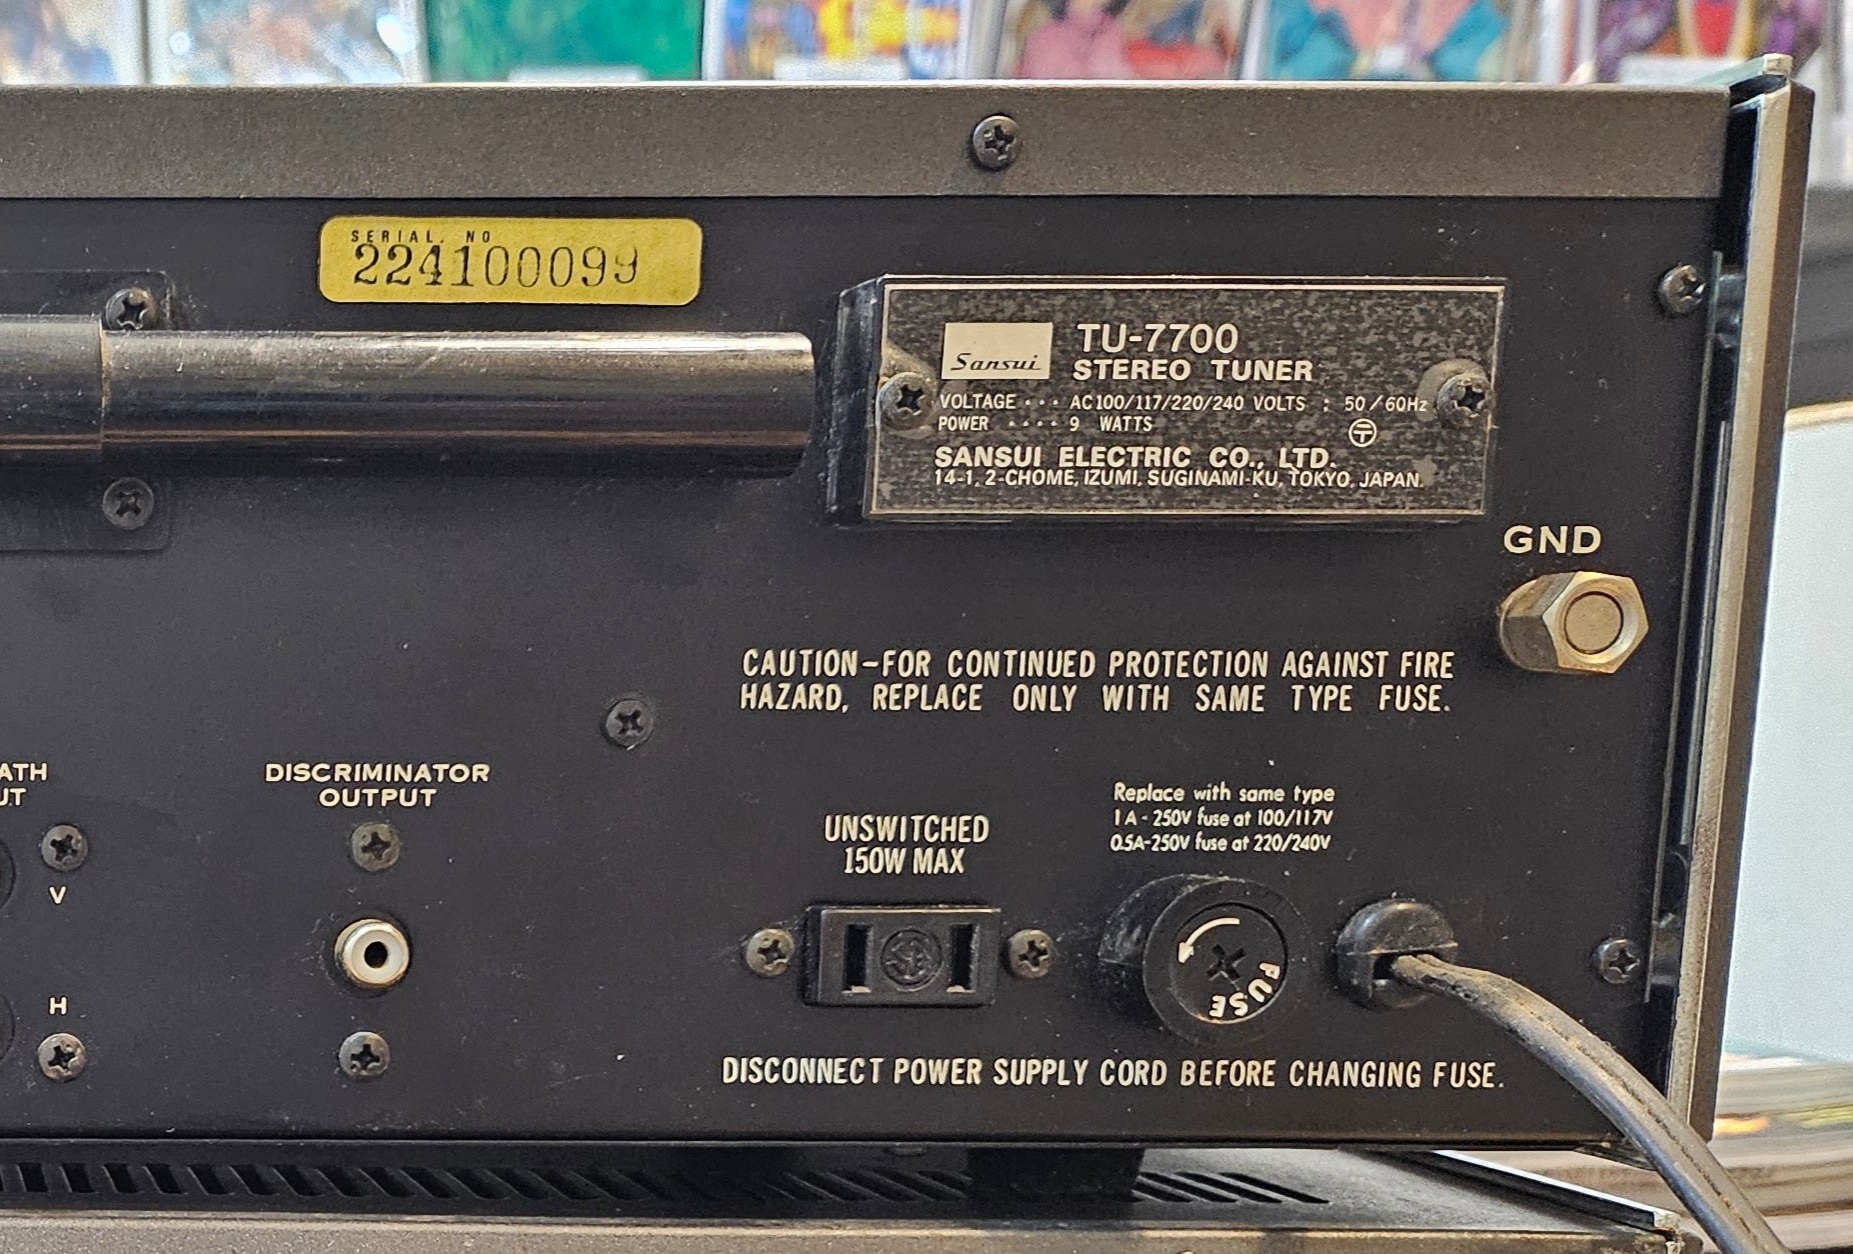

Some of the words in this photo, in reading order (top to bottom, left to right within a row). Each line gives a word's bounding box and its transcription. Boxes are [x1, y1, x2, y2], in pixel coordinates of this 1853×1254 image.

[465, 230, 491, 244] NO
[1077, 323, 1239, 354] TU-7700
[950, 352, 1041, 371] Sansui
[1072, 358, 1191, 381] STEREO
[1210, 359, 1313, 382] TUNER
[938, 415, 989, 432] POWER
[1069, 415, 1080, 432] 9
[1099, 415, 1153, 432] WATTS
[934, 445, 1042, 468] SANSUI
[1058, 445, 1192, 468] ELECTRIC
[1209, 446, 1265, 470] CO.,
[1278, 446, 1337, 469] LTD.
[1503, 524, 1601, 554] GND
[947, 649, 1096, 678] CONTINUED
[1108, 649, 1269, 678] PROTECTION
[1281, 650, 1390, 679] AGAINST
[1400, 650, 1455, 679] FIRE
[740, 682, 849, 714] HAZARD,
[872, 683, 983, 711] REPLACE
[1012, 683, 1078, 712] ONLY
[1102, 683, 1170, 712] WITH
[1195, 683, 1266, 712] SAME
[1291, 684, 1353, 712] TYPE
[1379, 683, 1450, 712] FUSE.
[265, 762, 490, 783] DISCRIMINATOR
[319, 787, 437, 807] OUTPUT
[1114, 781, 1185, 804] Replace
[1193, 780, 1232, 802] with
[1239, 788, 1286, 802] same
[1293, 785, 1336, 805] type
[824, 814, 990, 843] UNSWITCHED
[1195, 830, 1228, 852] fuse
[1231, 835, 1250, 852] at
[1253, 832, 1331, 852] 220/240V
[844, 846, 907, 875] 150W
[913, 846, 965, 875] MAX
[49, 886, 67, 904] V
[1208, 960, 1281, 1018] FUSE
[49, 996, 67, 1015] H
[722, 1056, 885, 1085] DISCONNECT
[893, 1057, 983, 1085] POWER
[993, 1057, 1089, 1086] SUPPLY
[1100, 1058, 1168, 1087] CORD
[1180, 1059, 1277, 1087] BEFORE
[1289, 1059, 1422, 1089] CHANGING
[1433, 1061, 1504, 1088] FUSE.
